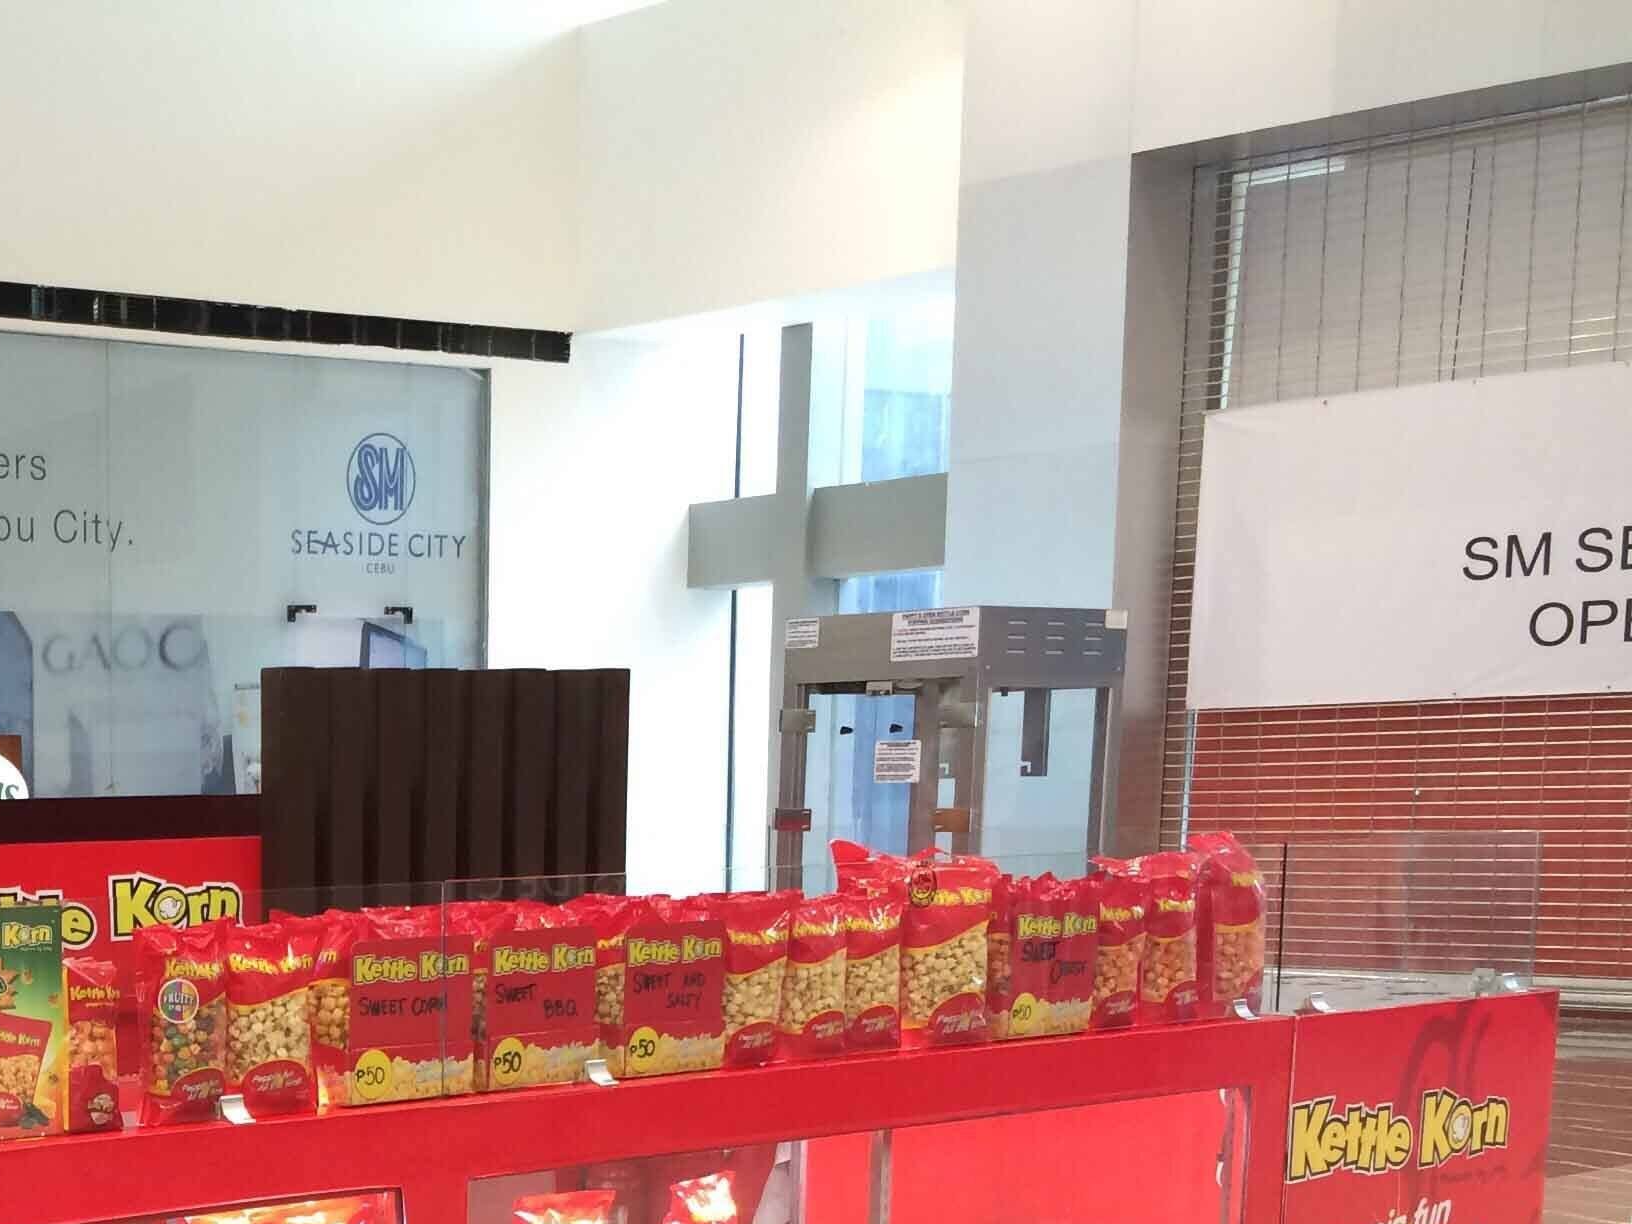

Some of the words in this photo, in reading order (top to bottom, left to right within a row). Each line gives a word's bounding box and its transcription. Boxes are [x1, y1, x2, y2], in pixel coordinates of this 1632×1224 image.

[353, 443, 408, 511] SM
[52, 508, 134, 552] City.
[291, 529, 400, 558] SEASIDE
[407, 533, 467, 559] CITY
[365, 562, 396, 575] CEBU
[1462, 531, 1553, 581] SM
[109, 873, 243, 942] Korn
[1, 921, 53, 949] Korn
[1018, 912, 1062, 939] Kettle
[493, 945, 551, 976] Kettle
[551, 943, 597, 973] Korn
[626, 938, 681, 967] Kettle
[681, 934, 724, 964] Korn
[353, 952, 418, 985] Kettle
[419, 950, 470, 982] Korn
[358, 997, 407, 1016] SWEET
[1286, 1095, 1413, 1185] Kettle
[1417, 1087, 1510, 1169] Korn
